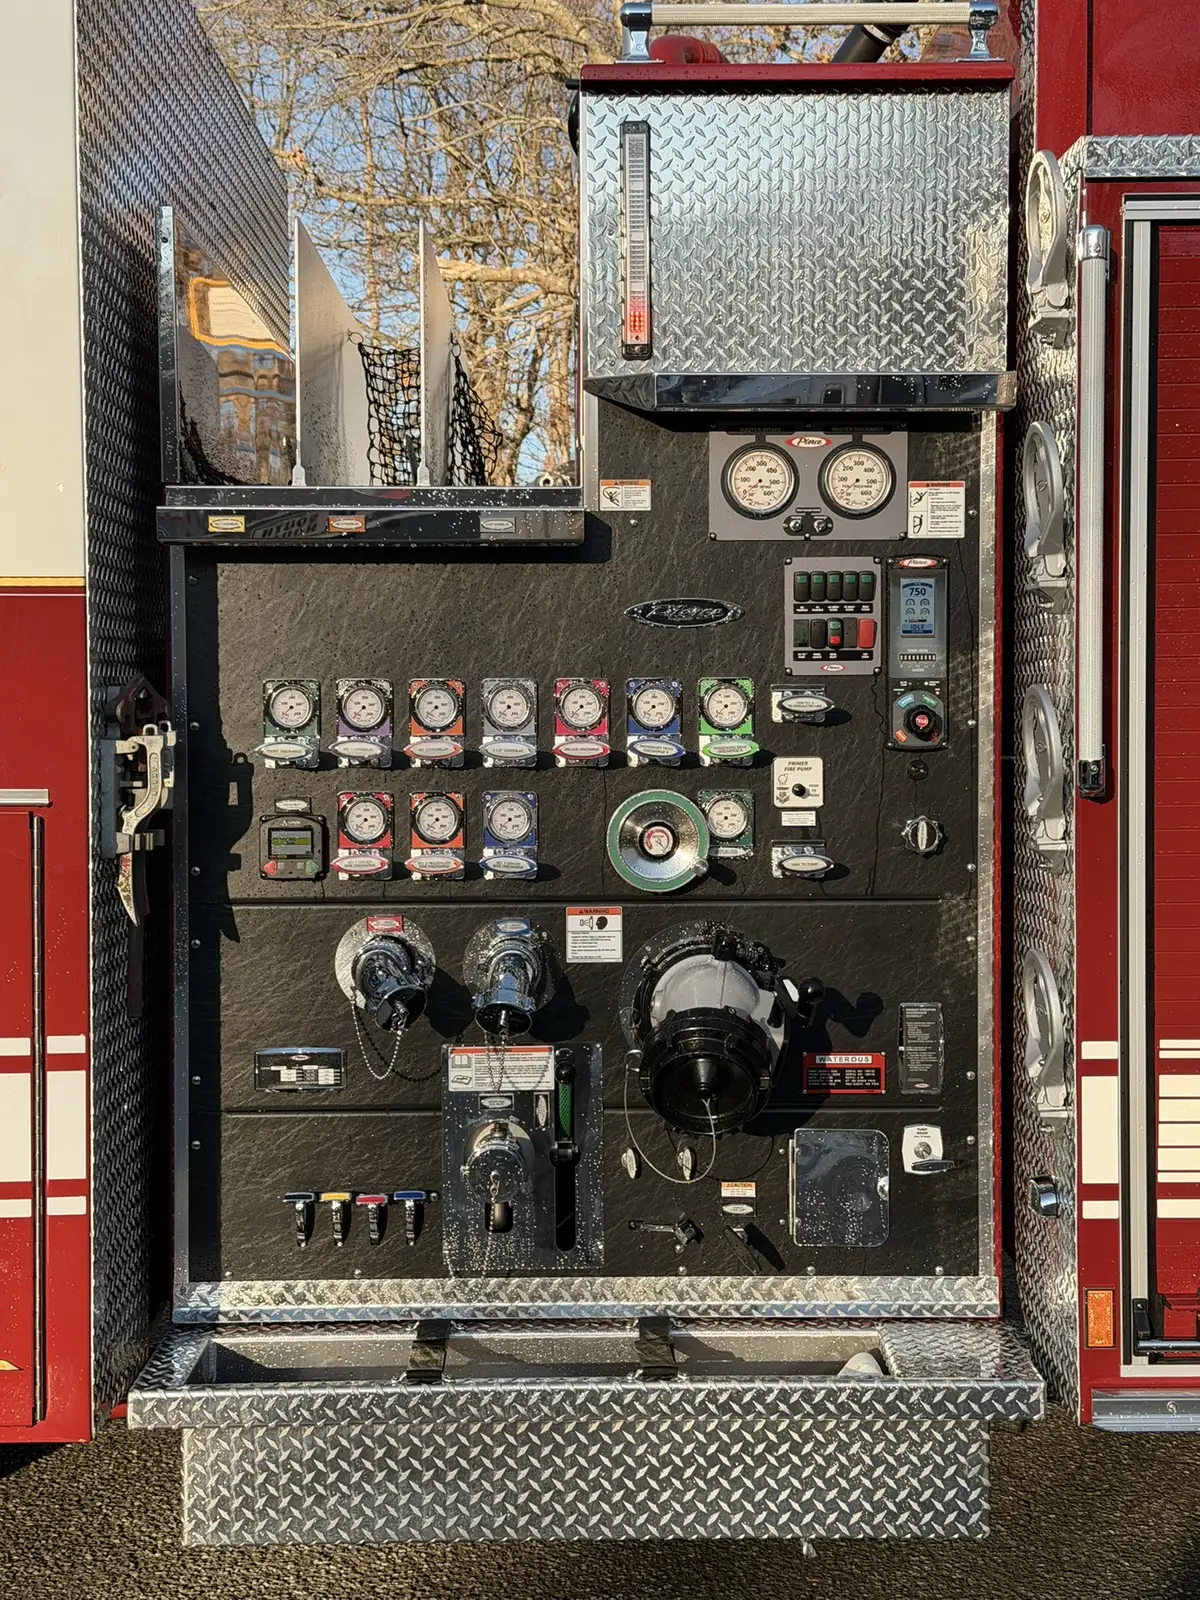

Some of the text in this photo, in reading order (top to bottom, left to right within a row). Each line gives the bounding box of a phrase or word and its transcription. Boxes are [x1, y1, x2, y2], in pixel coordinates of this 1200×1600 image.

[907, 558, 928, 566] Pierce
[908, 587, 927, 596] 750
[645, 604, 725, 620] Pierce
